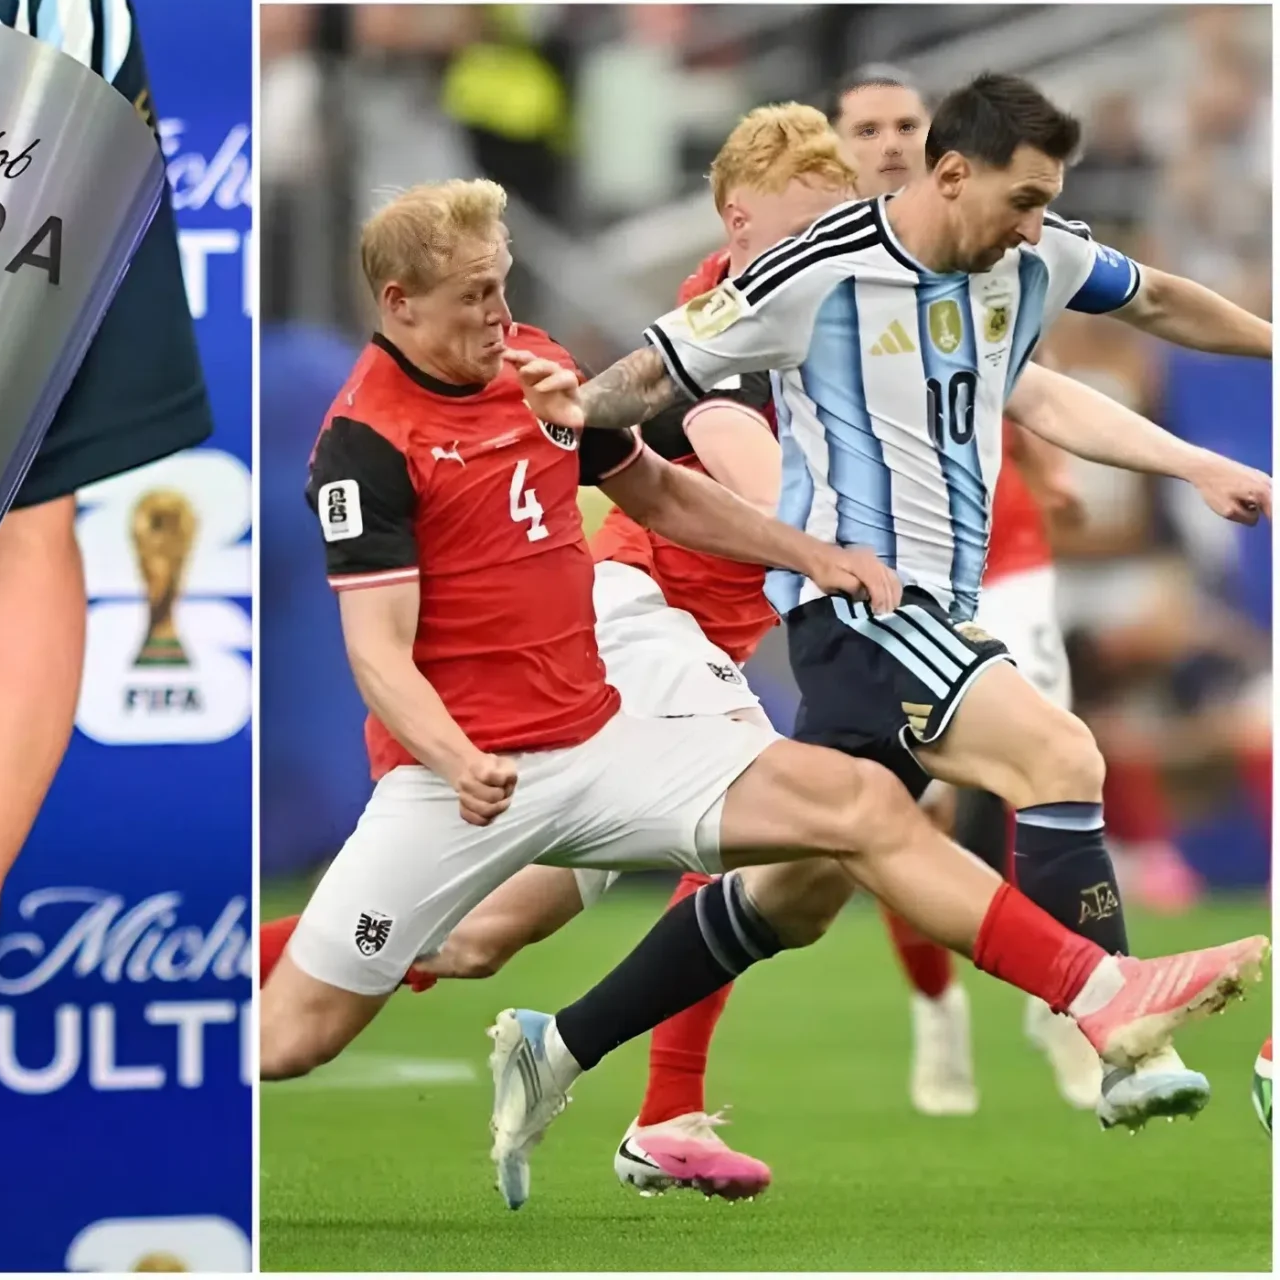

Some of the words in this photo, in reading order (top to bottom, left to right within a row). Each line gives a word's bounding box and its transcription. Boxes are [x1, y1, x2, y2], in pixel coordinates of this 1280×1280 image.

[926, 371, 978, 451] 10
[509, 458, 550, 542] 4
[124, 684, 203, 713] FIFA
